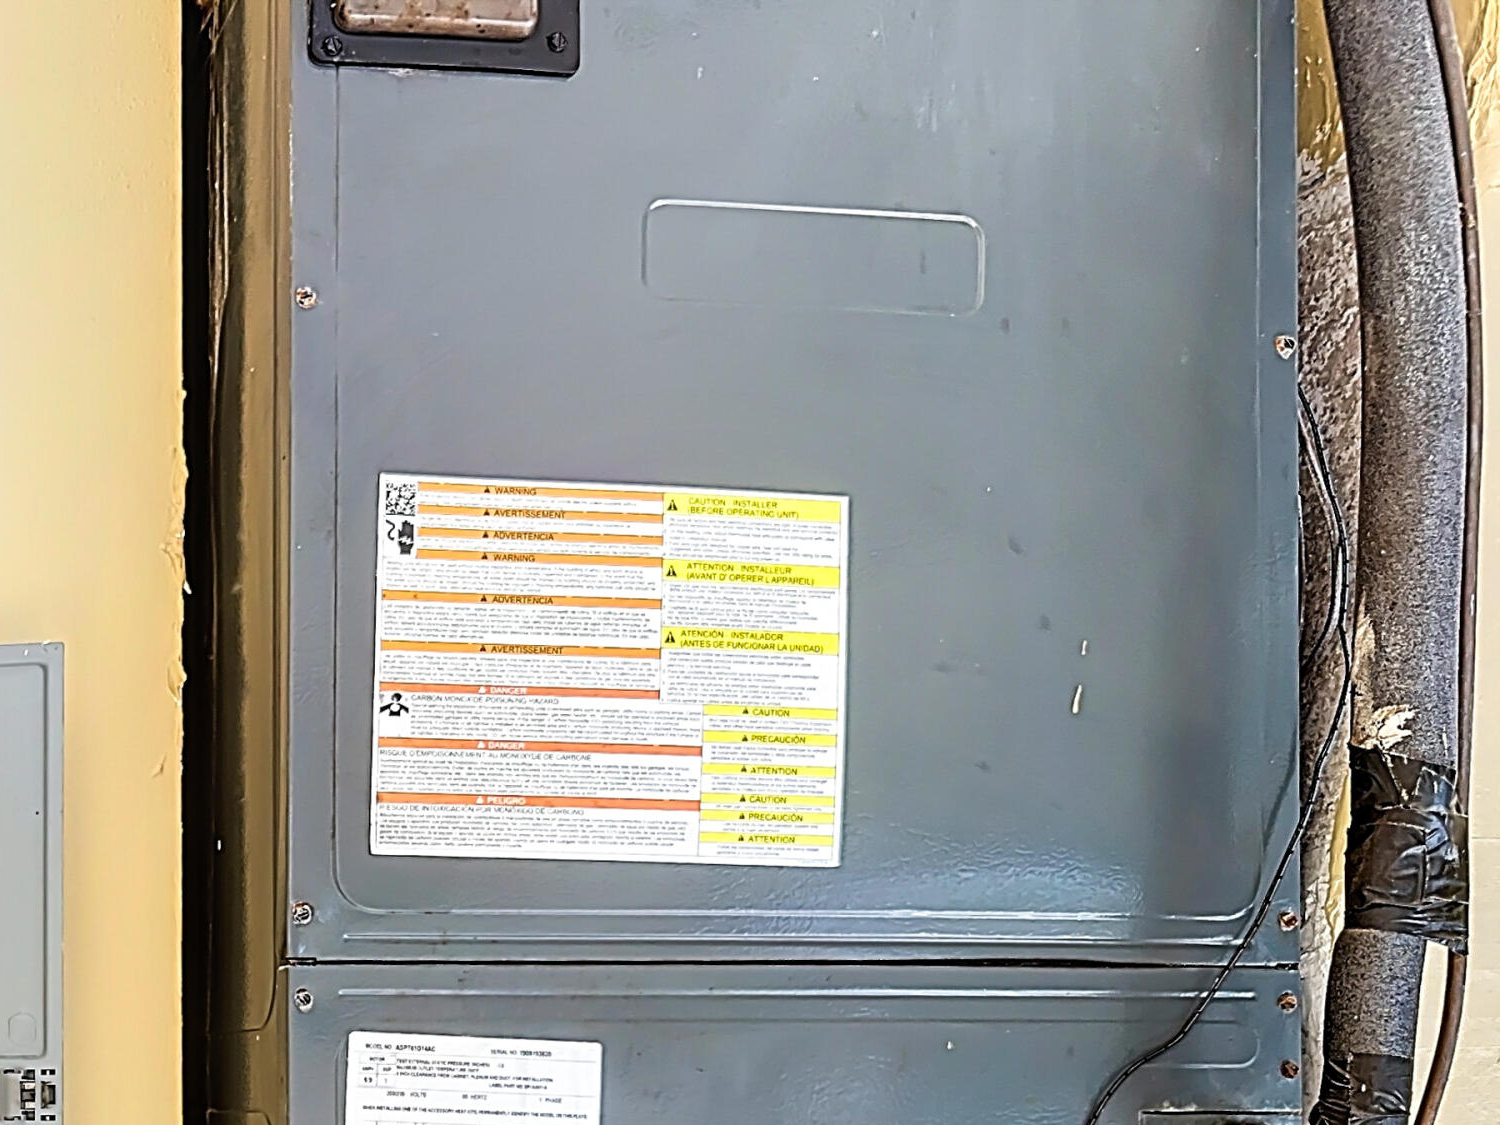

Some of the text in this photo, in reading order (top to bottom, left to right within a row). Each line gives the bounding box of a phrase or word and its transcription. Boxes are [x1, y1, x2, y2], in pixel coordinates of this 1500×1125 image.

[495, 487, 536, 496] WARNING
[689, 497, 778, 509] CAUTION INSTALLER
[494, 510, 566, 519] AVERTISSEMENT
[494, 531, 554, 540] ADVERTENCIA
[493, 554, 535, 562] WARNING
[687, 563, 734, 572] ATTENTION
[492, 595, 553, 604] ADVERTENCIA
[731, 632, 783, 641] INSTALADOR
[491, 646, 564, 654] AVERTISSEMENT
[752, 708, 790, 717] CAUTION
[750, 767, 797, 775] ATTENTION
[487, 797, 526, 805] PELIGRO
[749, 795, 786, 804] CAUTION
[748, 835, 795, 844] ATTENTION
